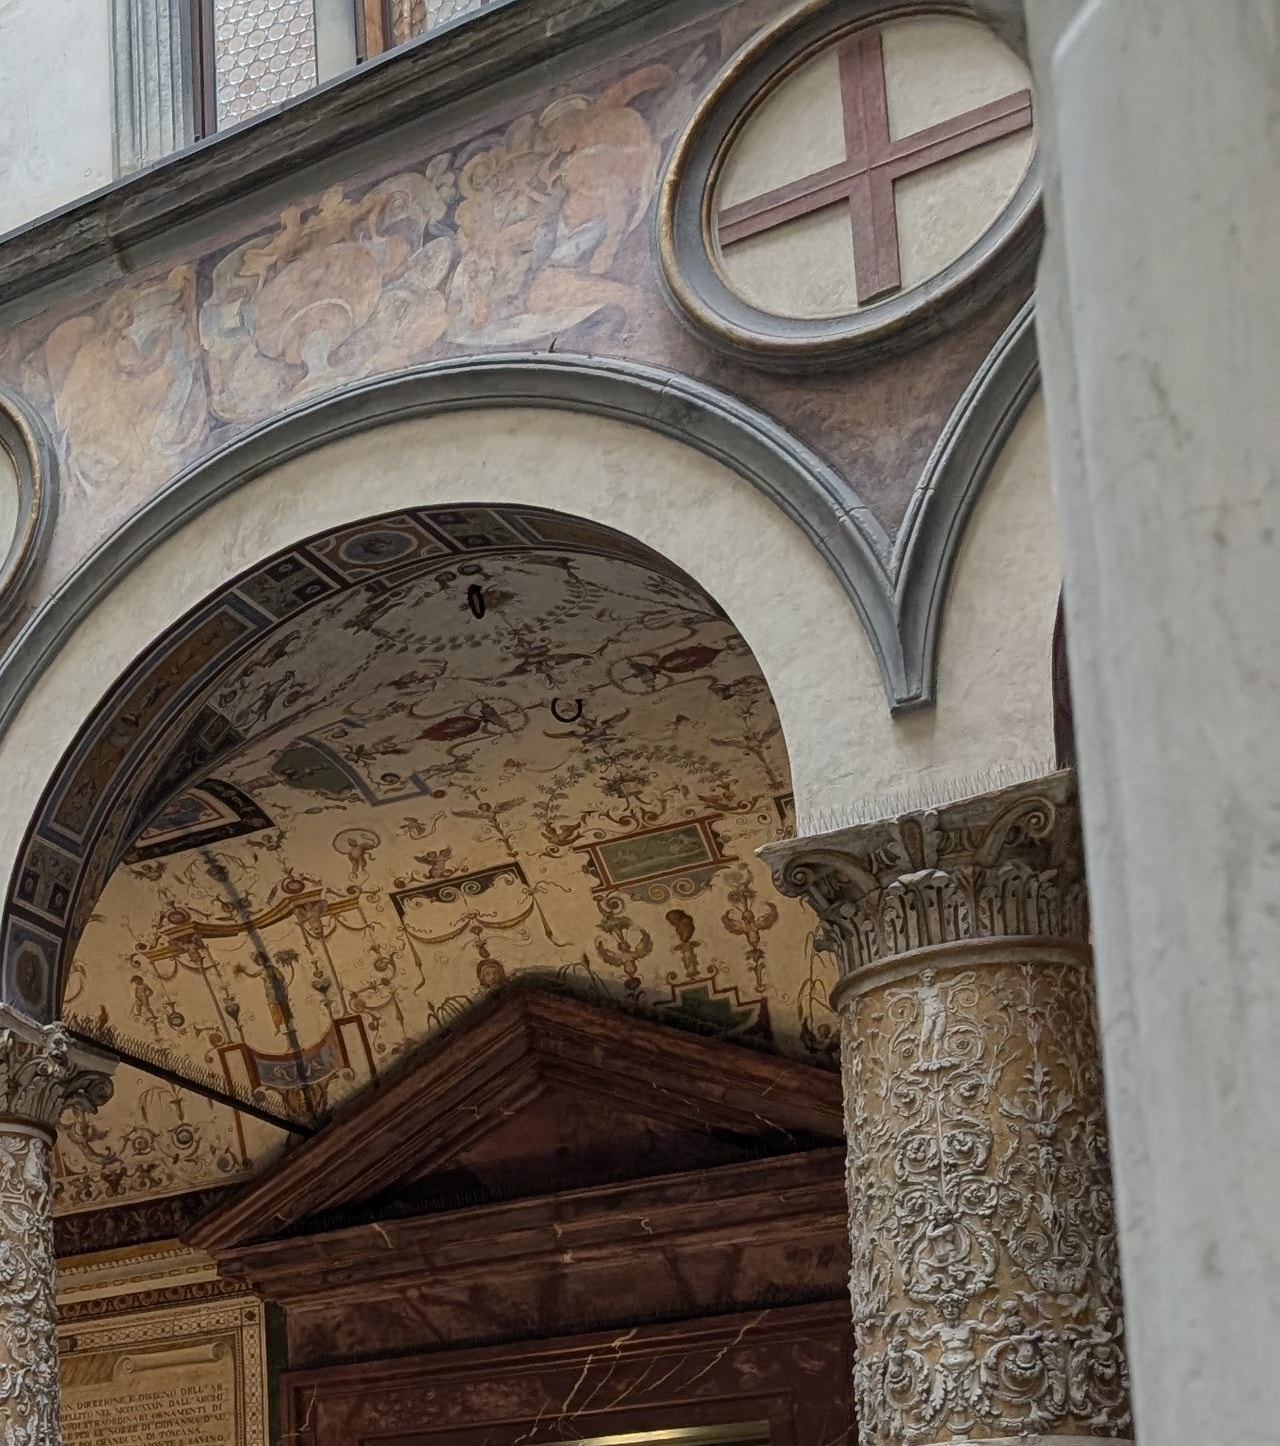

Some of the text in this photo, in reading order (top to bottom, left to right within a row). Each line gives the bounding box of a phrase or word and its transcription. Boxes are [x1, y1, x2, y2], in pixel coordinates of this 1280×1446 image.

[77, 1397, 126, 1410] DIREZIONE
[139, 1389, 176, 1402] DISEGNO
[96, 1408, 111, 1416] NEL
[152, 1406, 206, 1419] ORNAMENTI
[212, 1403, 222, 1412] DI
[94, 1427, 104, 1437] LE
[109, 1423, 138, 1435] NOZZE
[142, 1423, 151, 1432] DI
[155, 1417, 201, 1429] GIOVANNA
[146, 1432, 155, 1441] DI
